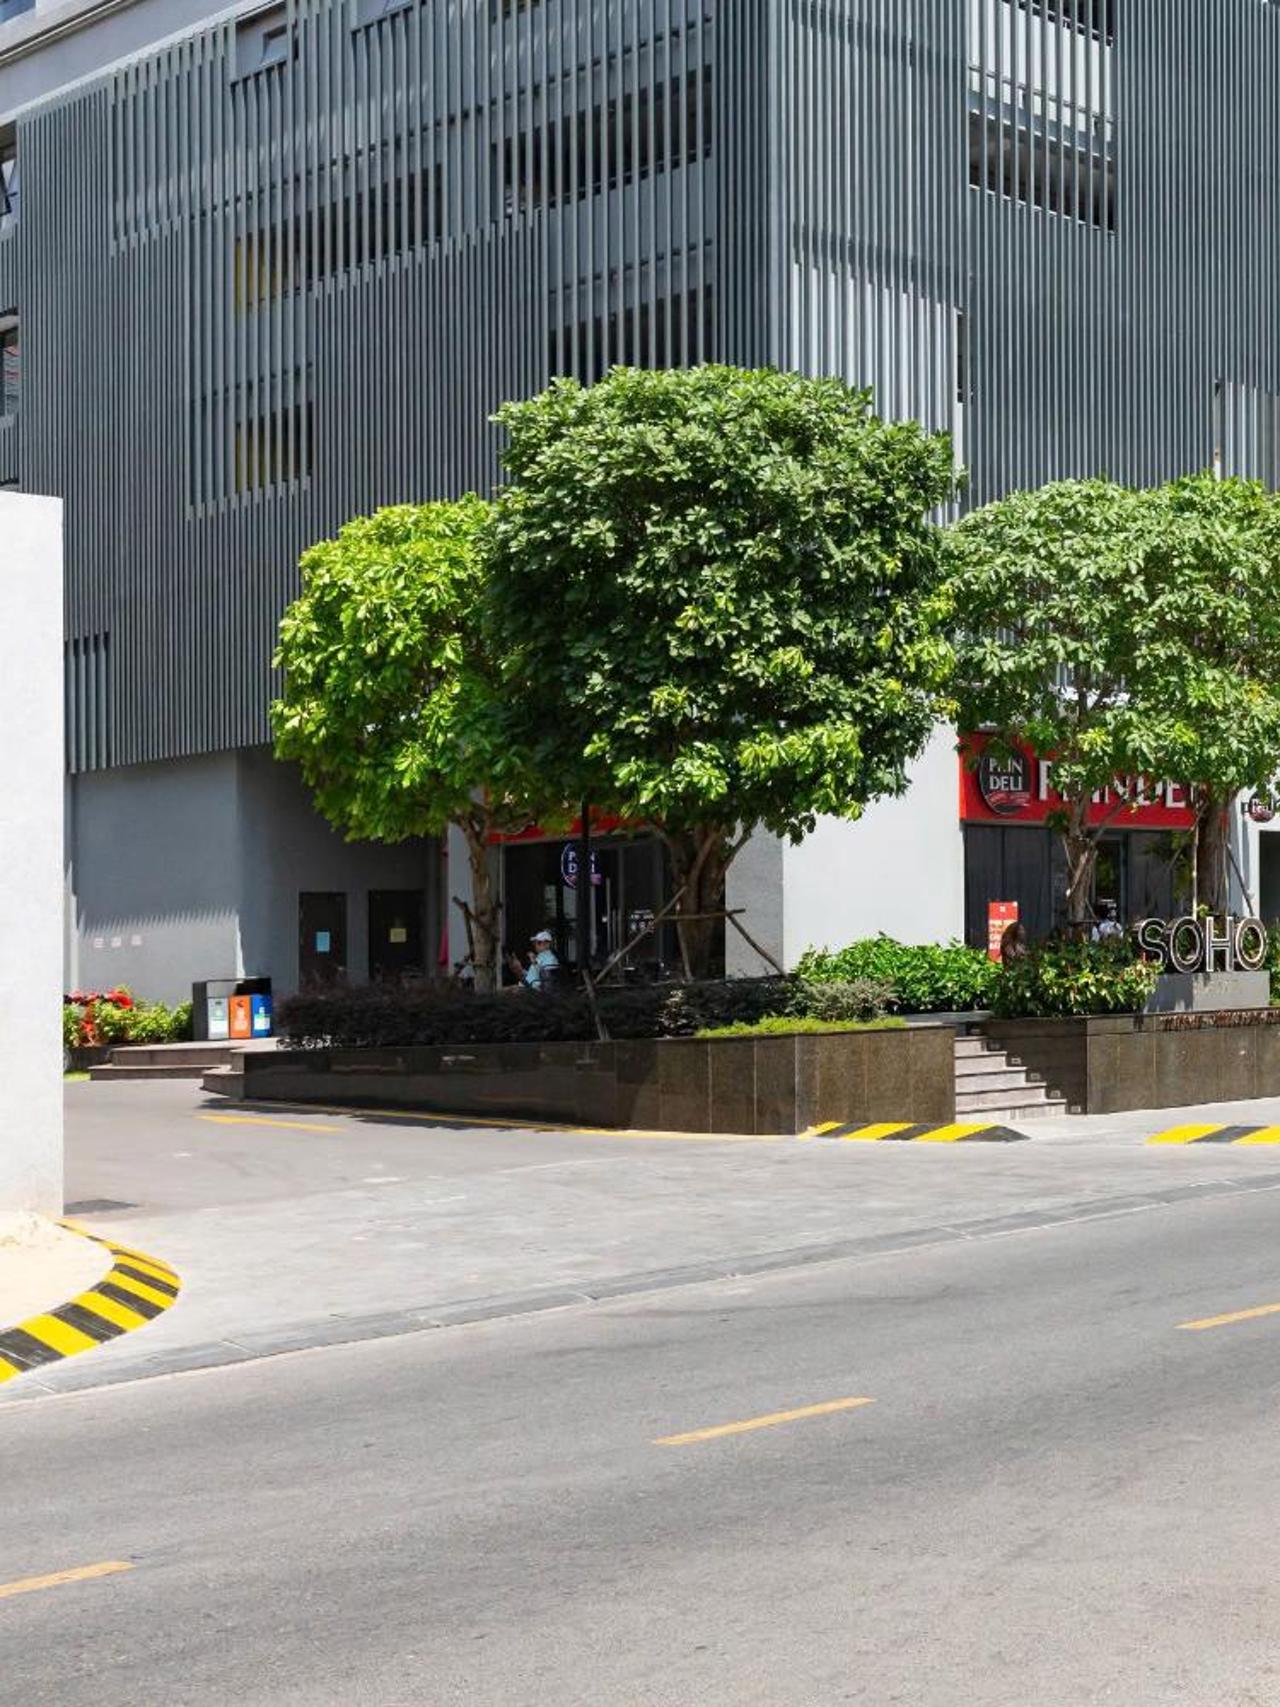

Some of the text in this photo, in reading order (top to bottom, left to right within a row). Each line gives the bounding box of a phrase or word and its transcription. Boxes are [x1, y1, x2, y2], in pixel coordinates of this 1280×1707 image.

[989, 757, 1024, 774] PIN
[989, 775, 1023, 791] DELI
[1138, 916, 1267, 973] SOHO
